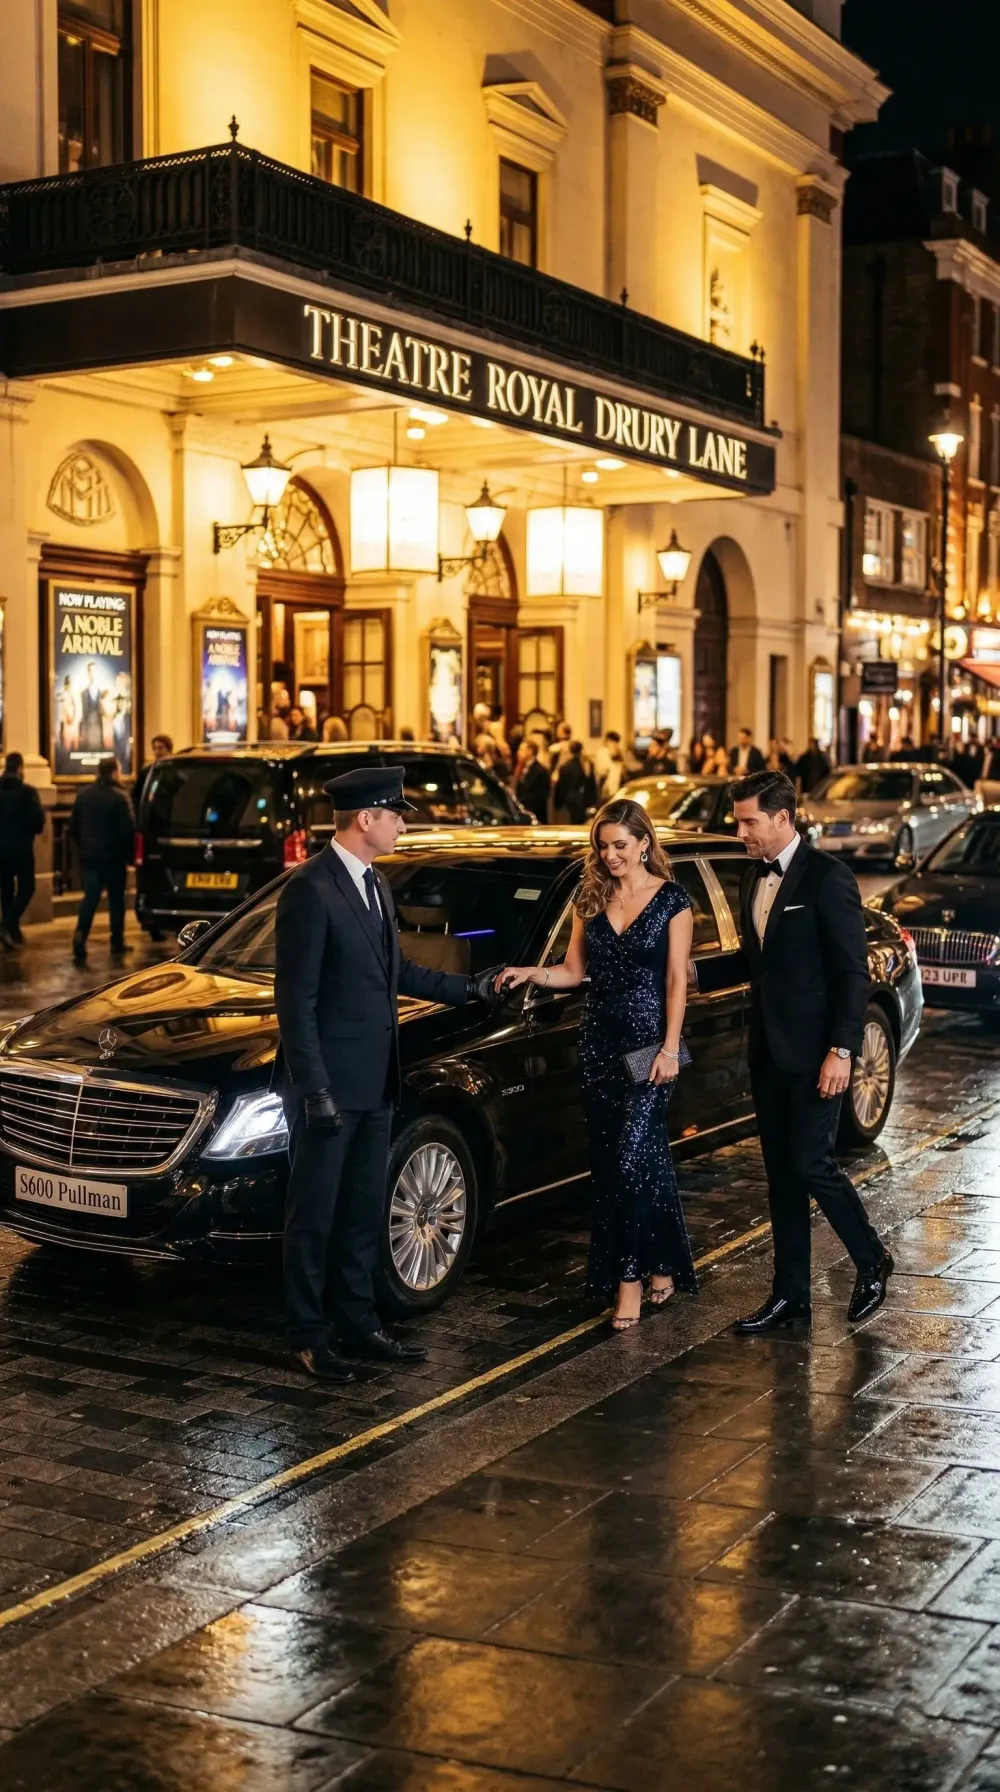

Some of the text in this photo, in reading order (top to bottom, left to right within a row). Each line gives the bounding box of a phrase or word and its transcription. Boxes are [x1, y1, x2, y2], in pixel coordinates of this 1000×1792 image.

[304, 304, 747, 480] THEATRE ROYAL DRURY LANE
[59, 592, 83, 607] NOW
[60, 613, 123, 637] A NOBLE
[61, 634, 123, 656] ARRIVAL
[943, 970, 967, 984] UPR
[20, 1173, 121, 1210] S600 Pullman
